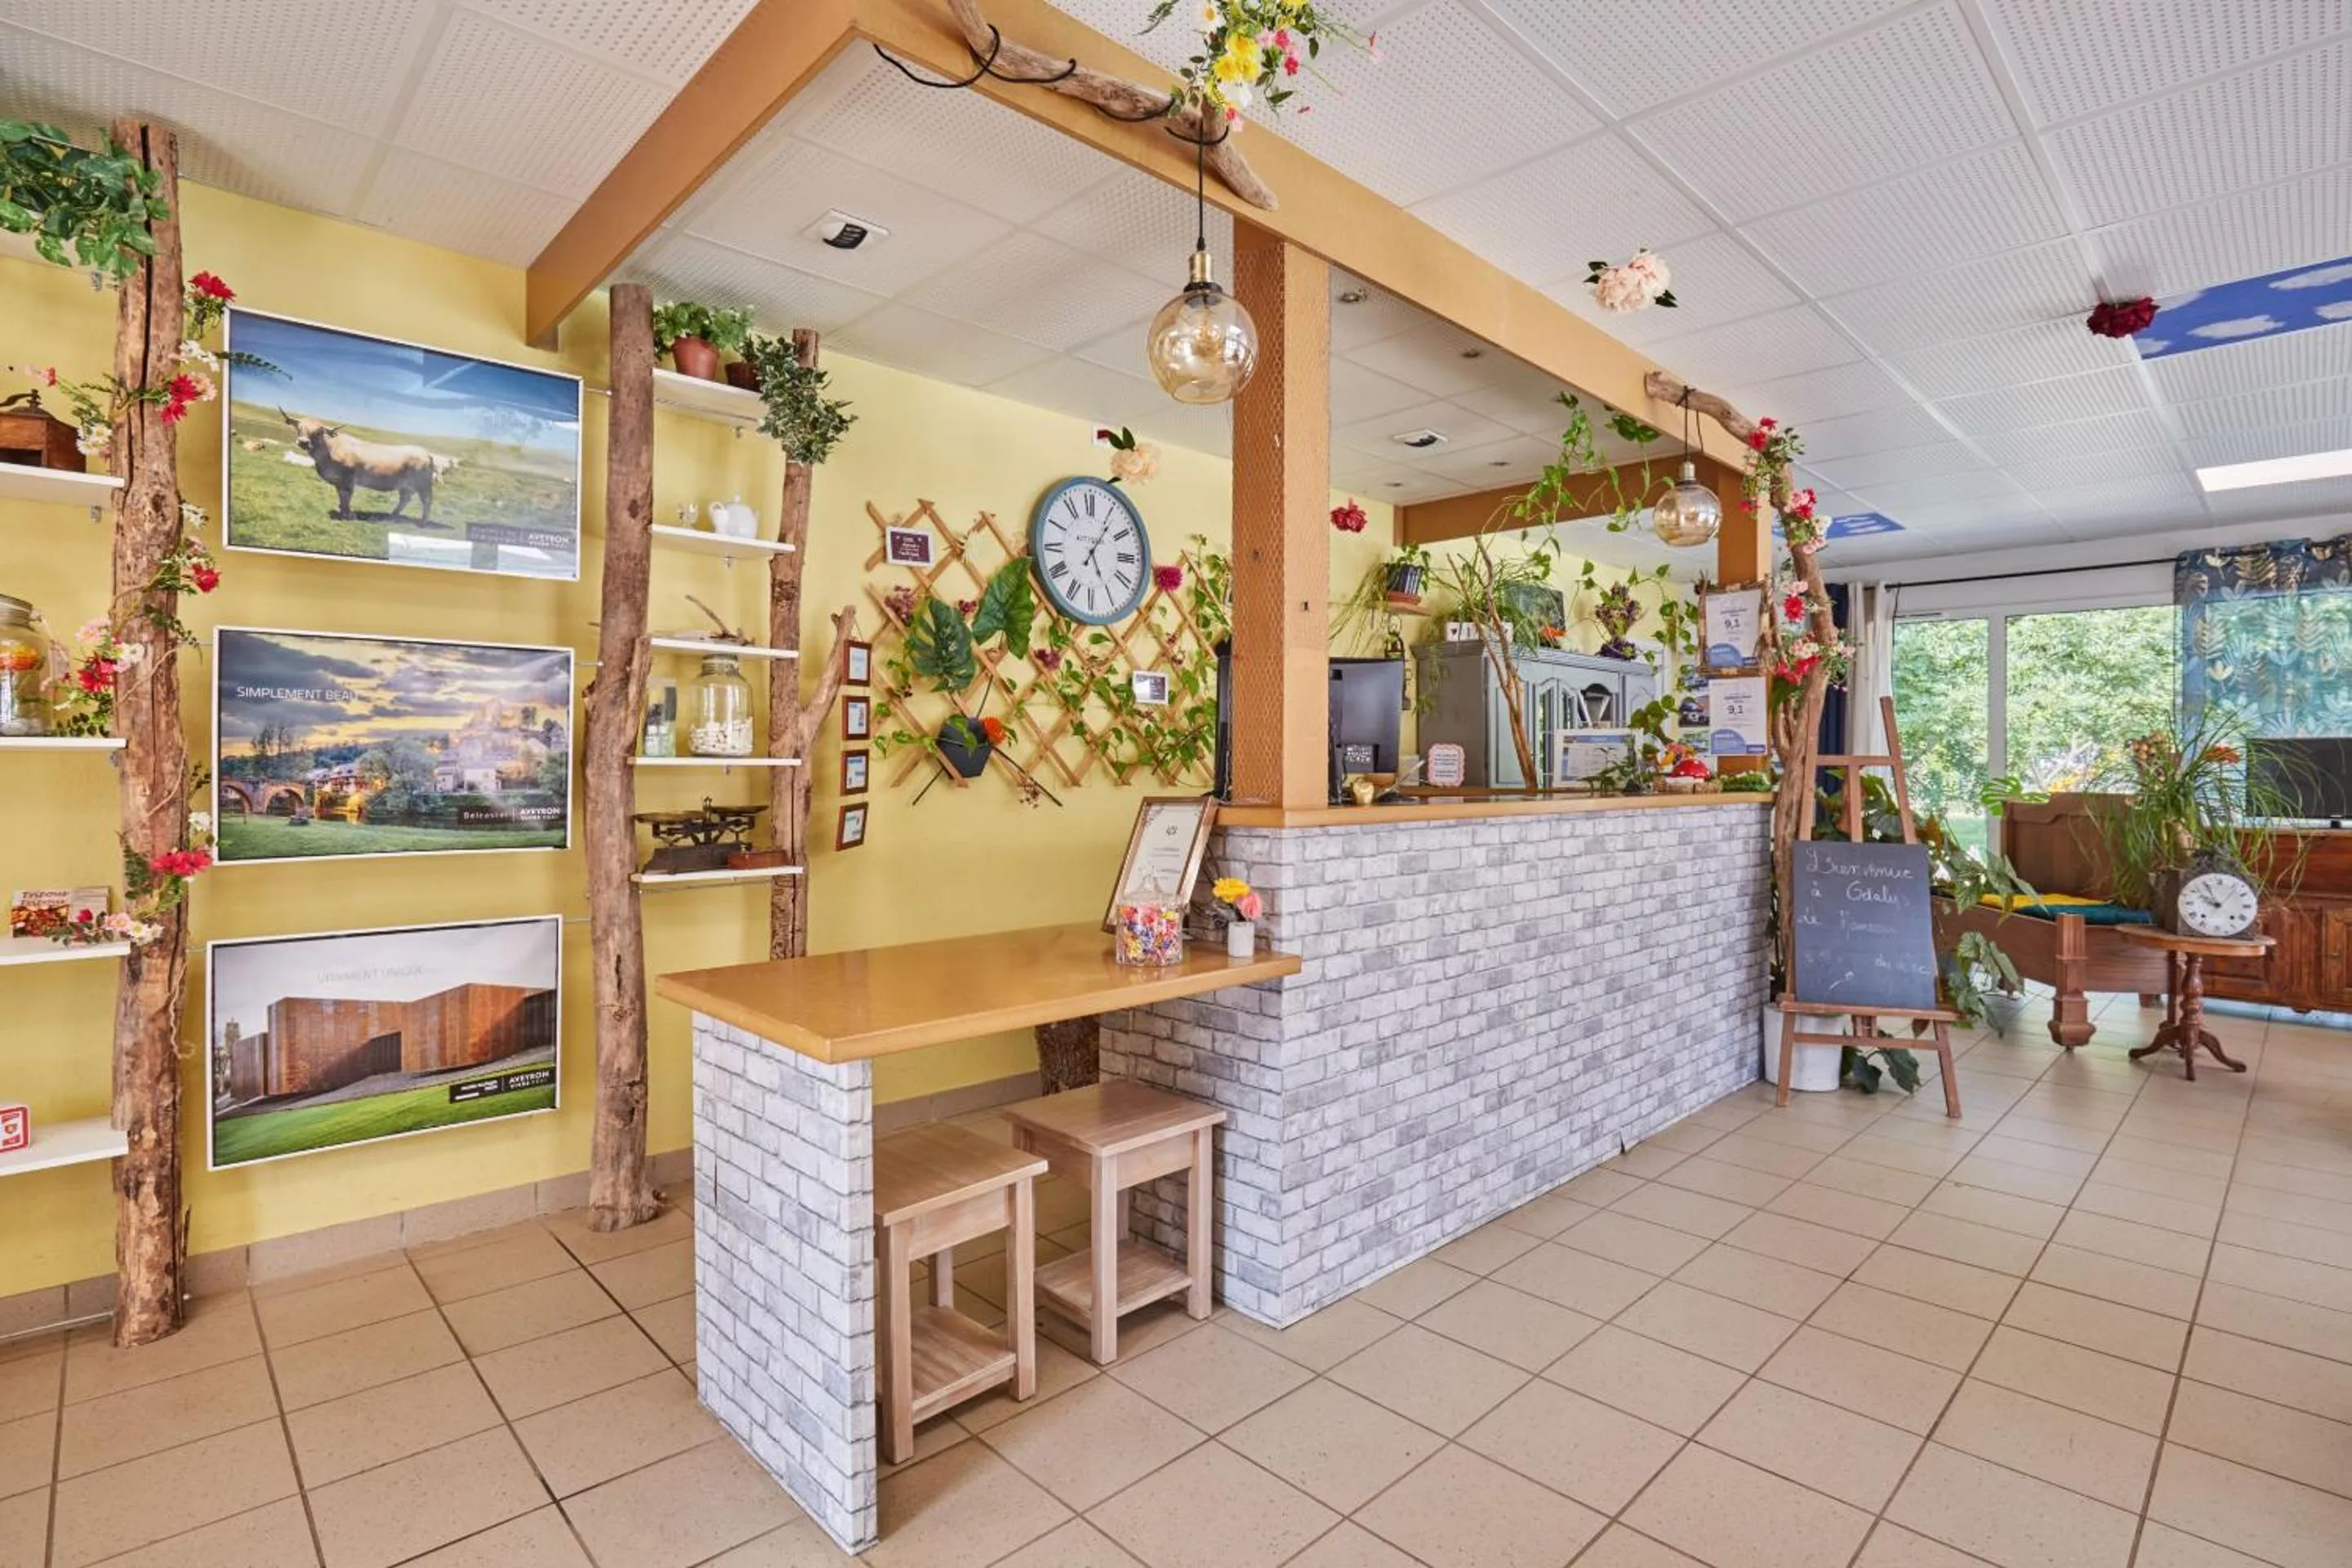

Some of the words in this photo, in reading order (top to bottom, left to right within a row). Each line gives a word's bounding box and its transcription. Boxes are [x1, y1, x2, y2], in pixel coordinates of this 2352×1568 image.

[237, 686, 322, 699] SIMPLEMENT
[520, 807, 560, 815] AVEYRON
[510, 1071, 550, 1084] AVEYRON
